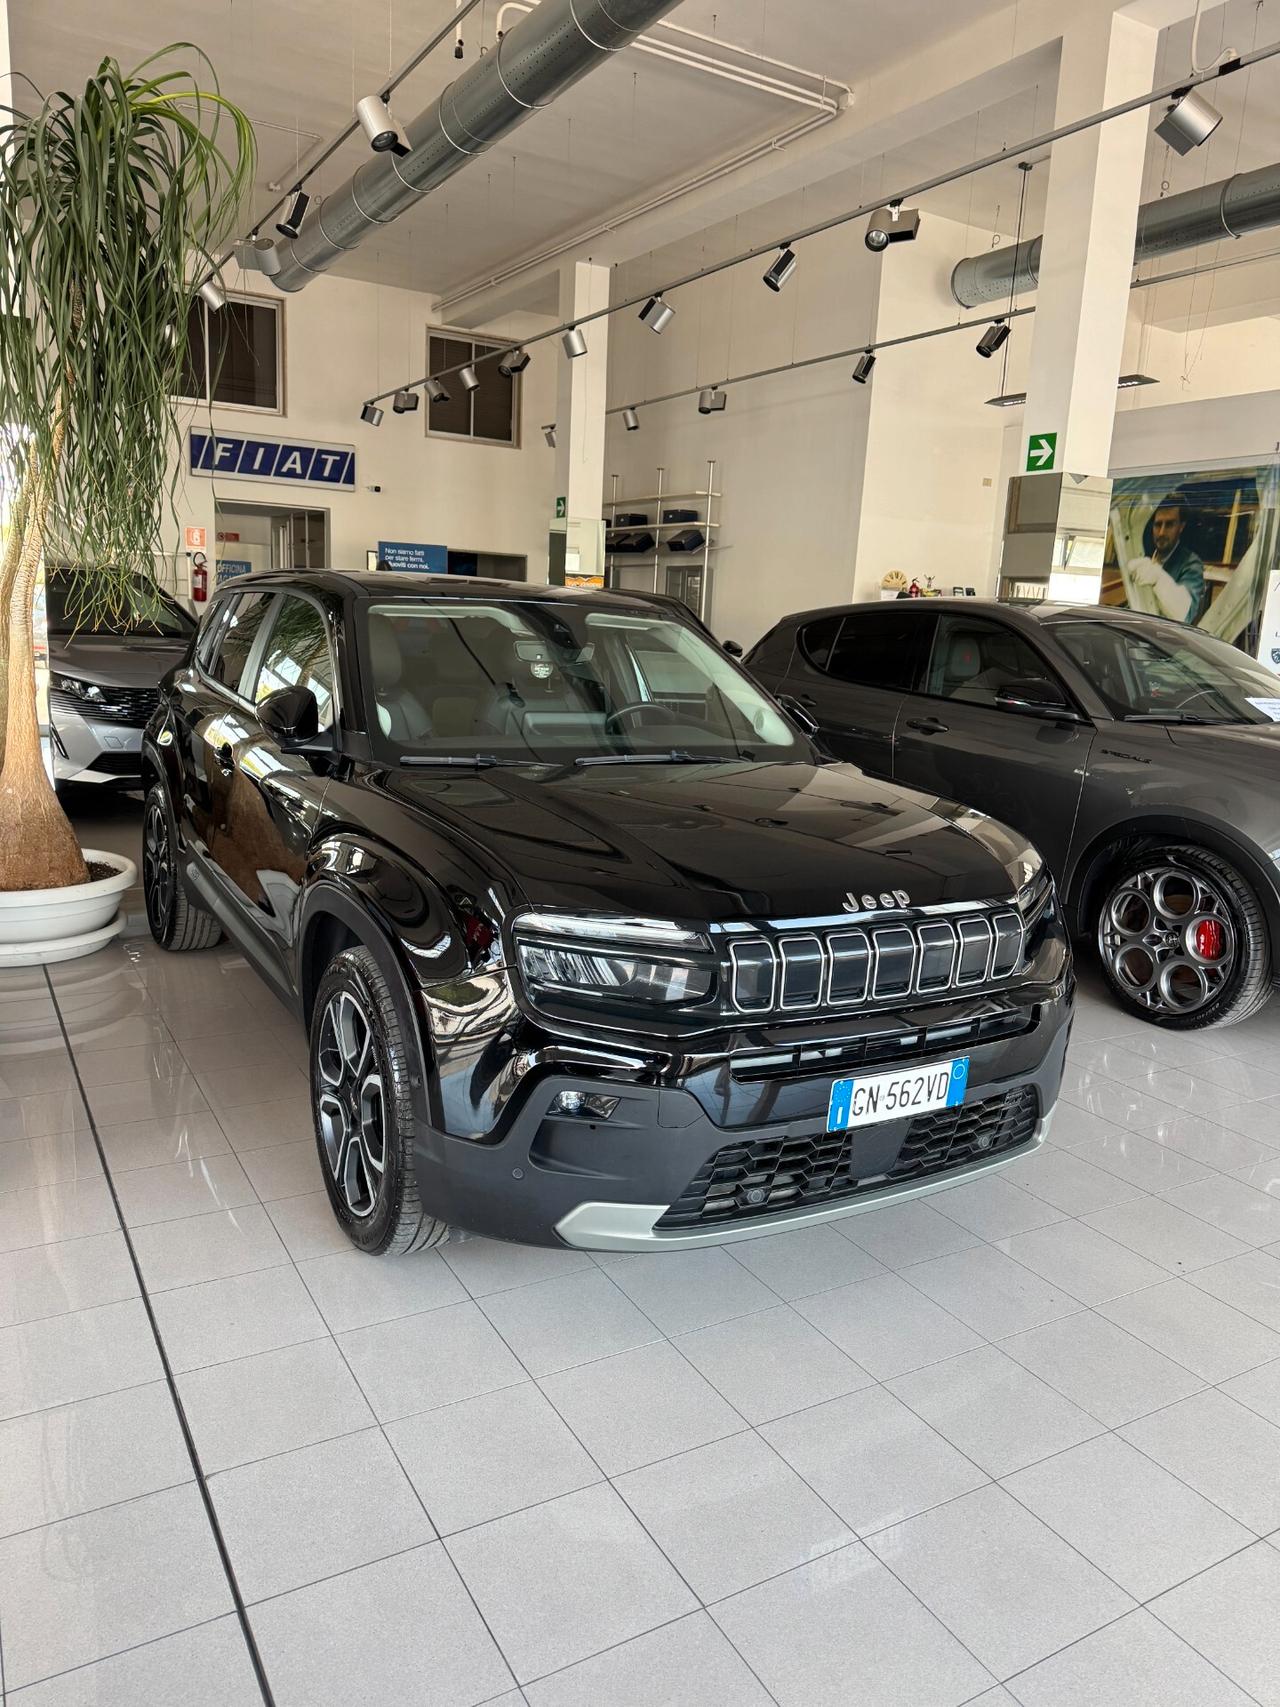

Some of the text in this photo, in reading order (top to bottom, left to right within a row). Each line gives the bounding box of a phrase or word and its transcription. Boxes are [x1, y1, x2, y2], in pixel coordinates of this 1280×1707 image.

[215, 443, 340, 477] FIAT
[217, 563, 246, 574] OFFICINA
[842, 890, 911, 911] Jeep
[852, 1084, 881, 1117] GN
[885, 1072, 950, 1110] 562VD
